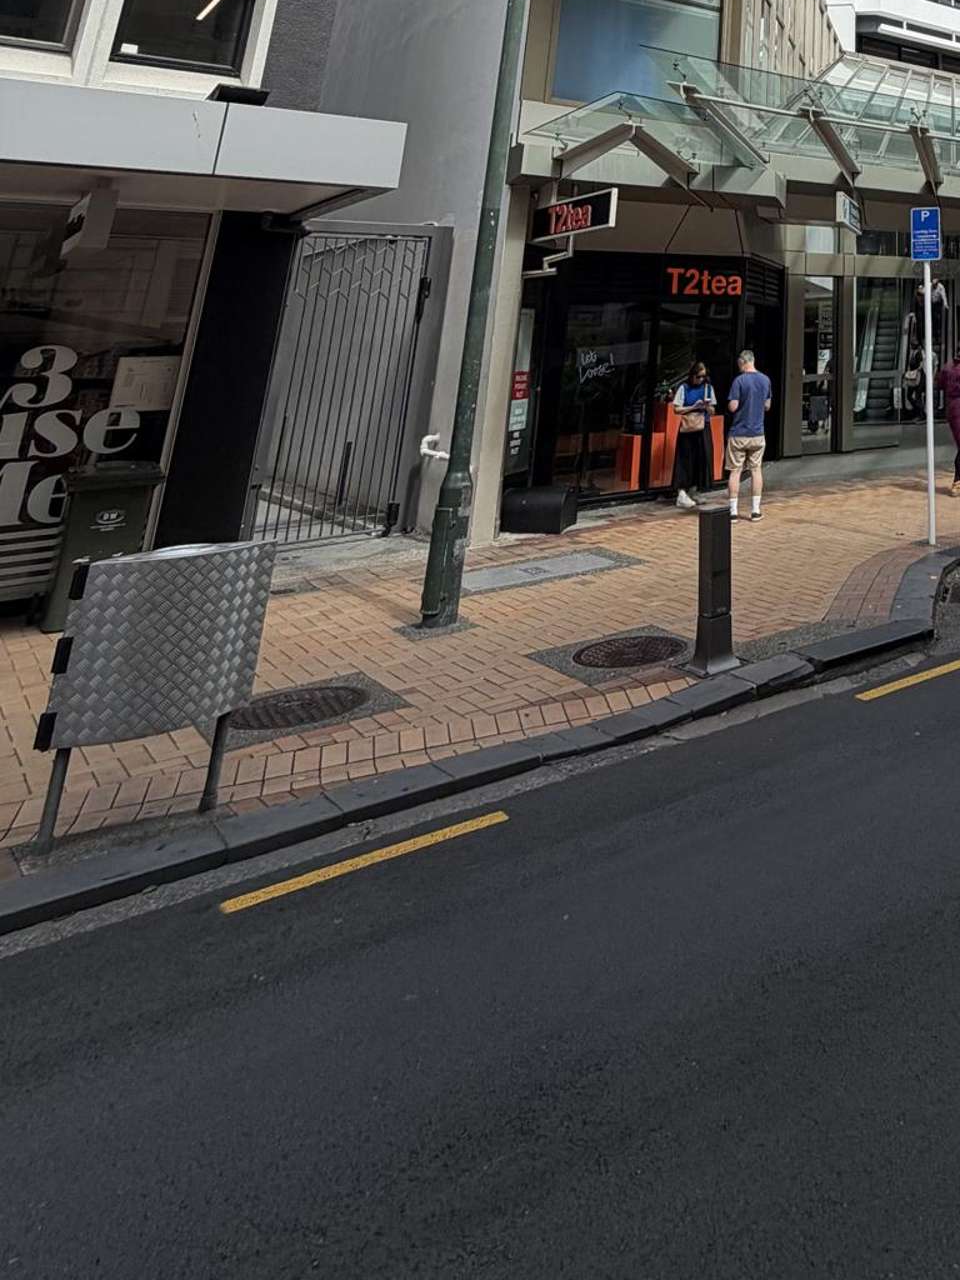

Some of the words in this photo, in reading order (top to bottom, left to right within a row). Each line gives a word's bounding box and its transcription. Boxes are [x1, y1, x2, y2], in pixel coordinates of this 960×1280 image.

[548, 204, 592, 234] T2tea
[921, 210, 930, 222] P
[667, 268, 742, 295] T2tea
